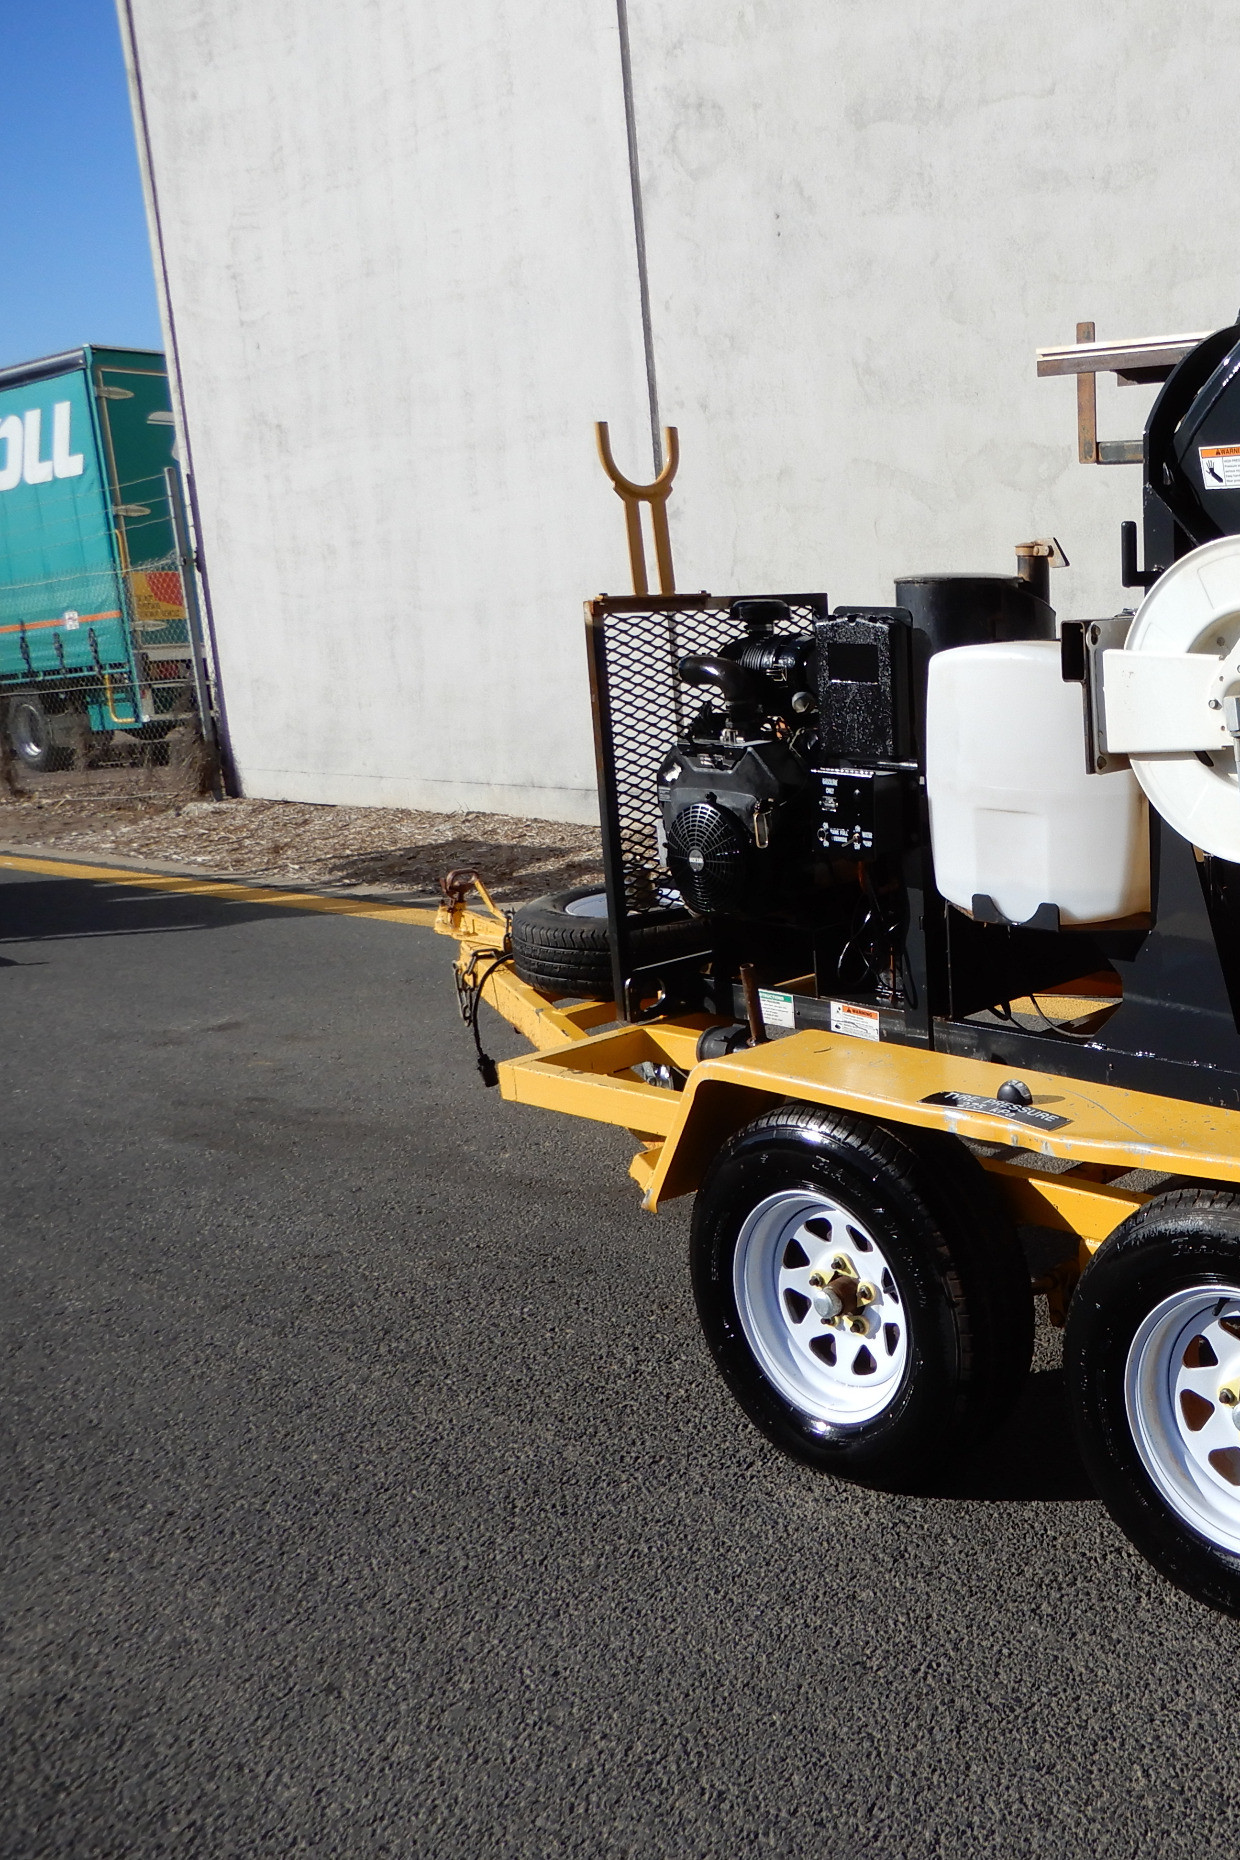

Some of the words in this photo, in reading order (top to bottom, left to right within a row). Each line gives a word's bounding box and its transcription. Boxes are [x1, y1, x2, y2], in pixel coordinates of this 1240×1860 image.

[944, 1092, 980, 1101] TYRE
[985, 1099, 1059, 1122] PRESSURE
[957, 1102, 985, 1110] 275
[989, 1106, 1016, 1118] kPa
